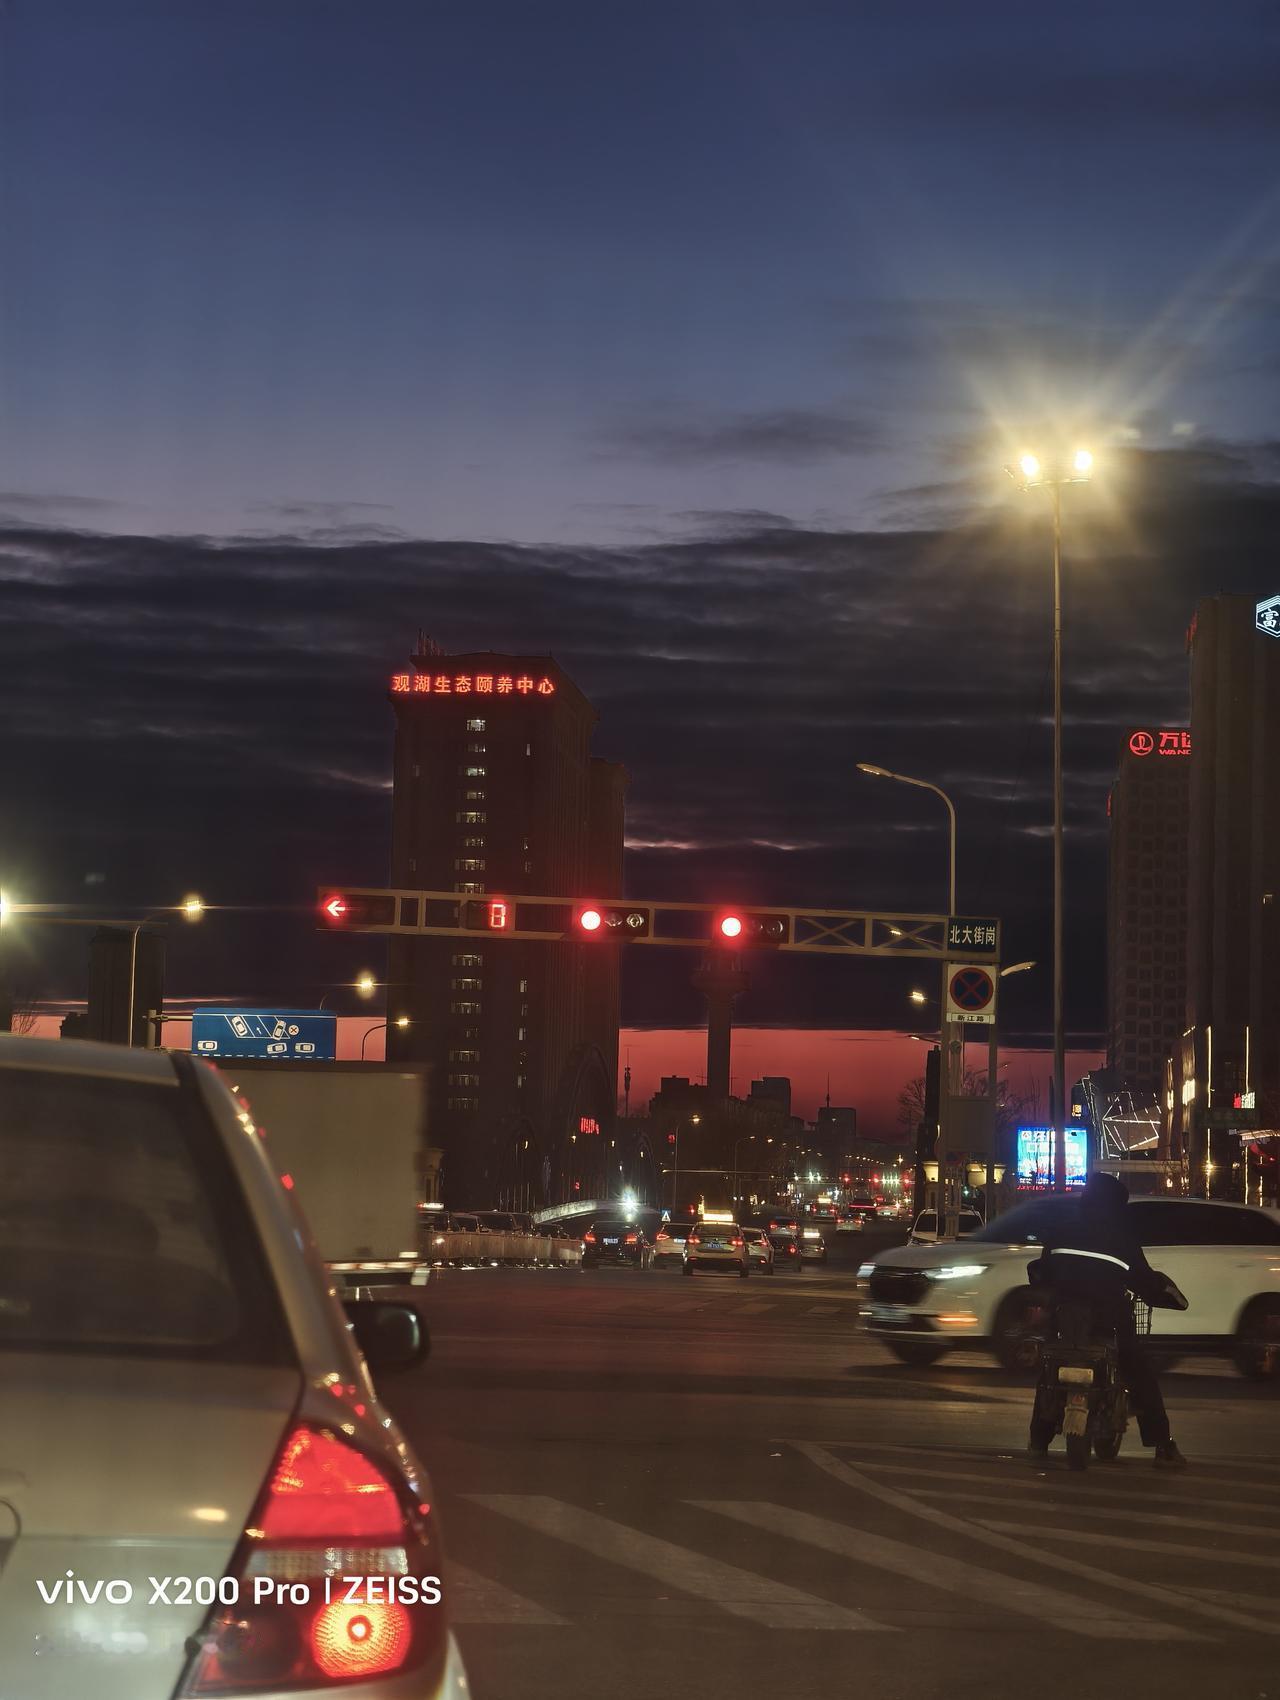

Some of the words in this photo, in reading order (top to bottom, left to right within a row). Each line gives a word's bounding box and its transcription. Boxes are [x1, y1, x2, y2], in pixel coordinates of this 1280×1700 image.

[392, 675, 555, 695] 观湖生态颐养中心
[949, 925, 996, 945] 北大街岗
